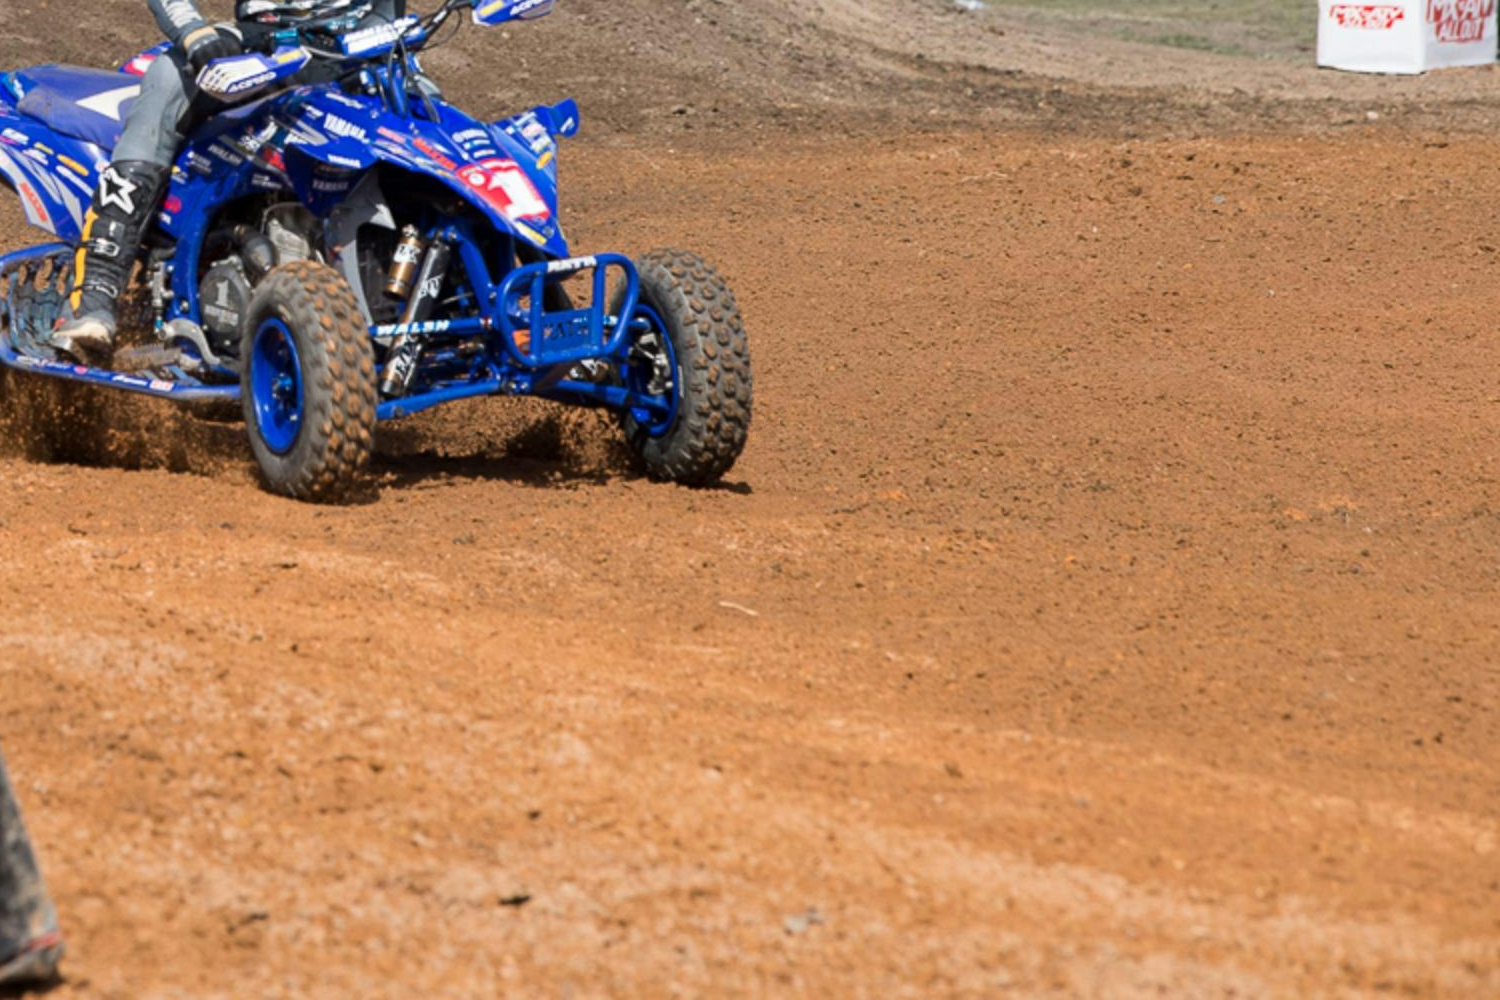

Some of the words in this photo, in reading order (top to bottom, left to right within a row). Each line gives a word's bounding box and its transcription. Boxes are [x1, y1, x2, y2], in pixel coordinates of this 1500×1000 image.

[323, 112, 367, 140] YAMAHA
[487, 168, 547, 220] 1
[215, 279, 229, 308] 1
[376, 319, 450, 336] WALSH
